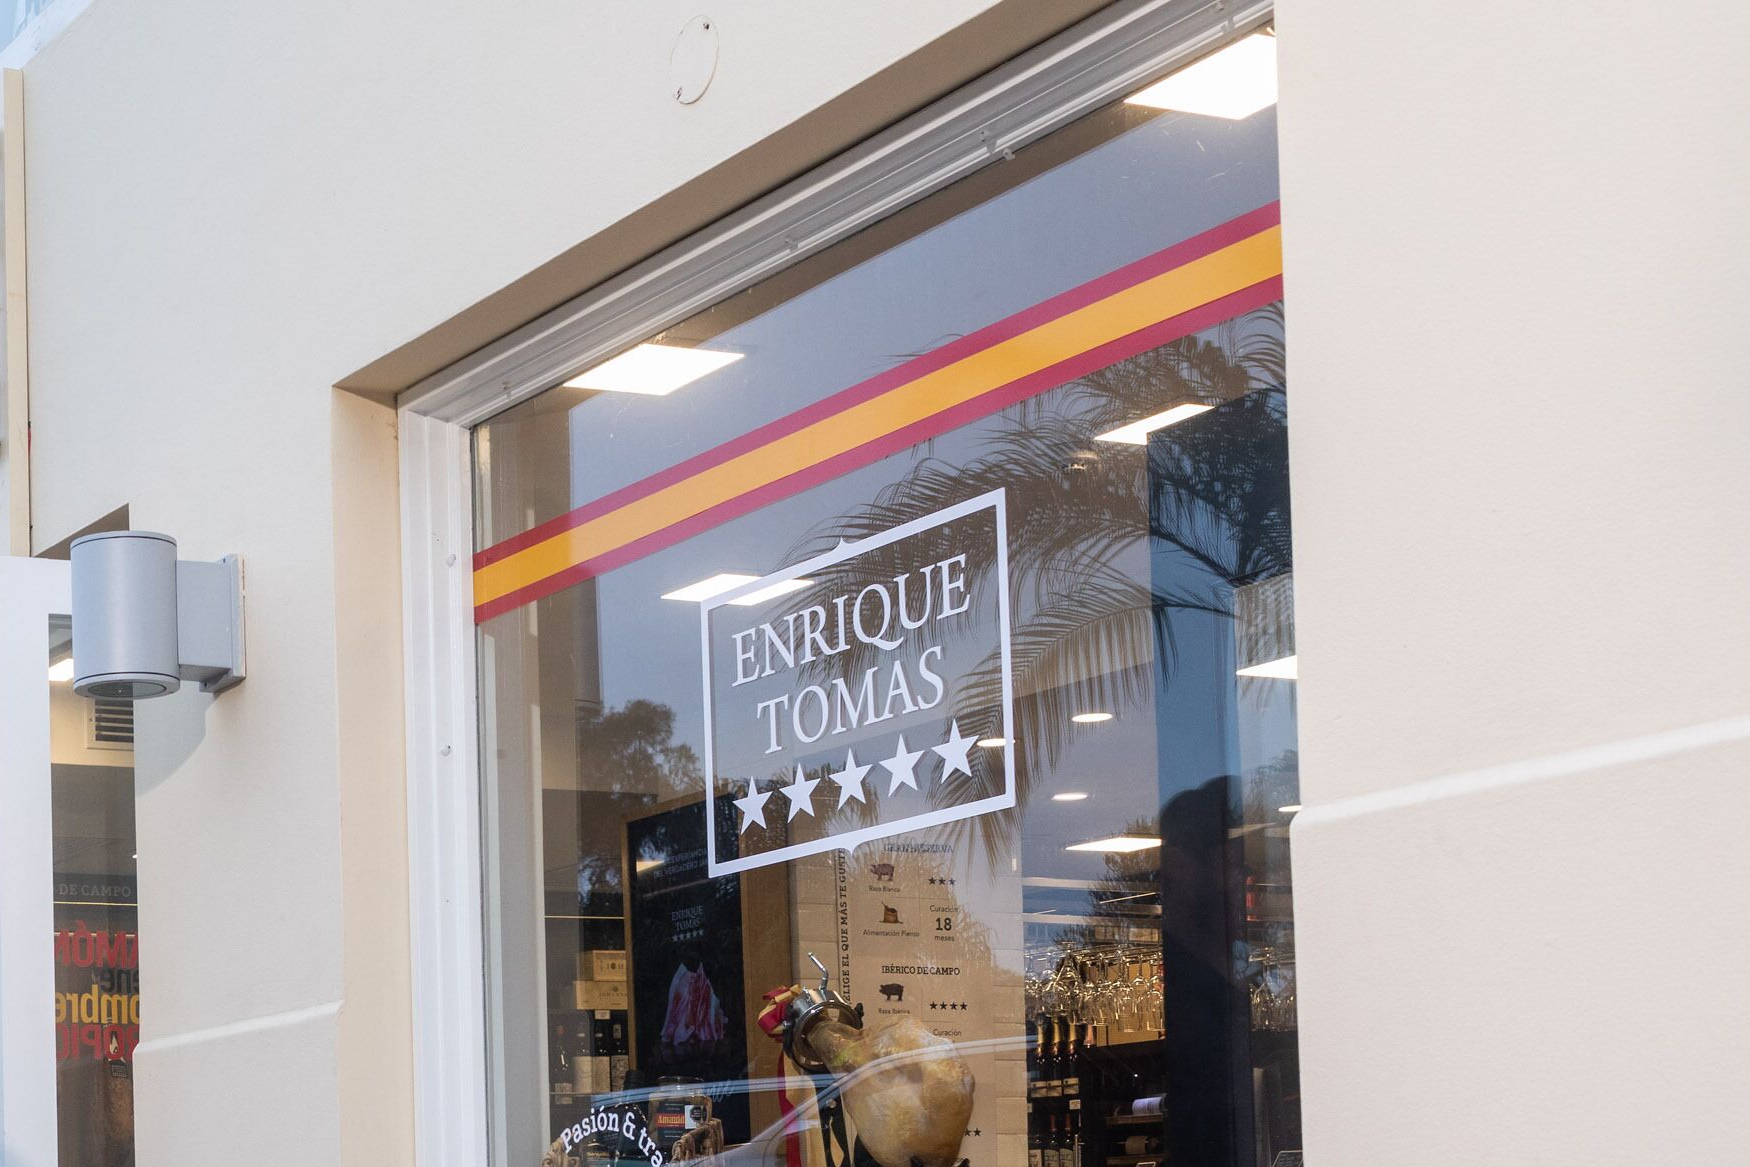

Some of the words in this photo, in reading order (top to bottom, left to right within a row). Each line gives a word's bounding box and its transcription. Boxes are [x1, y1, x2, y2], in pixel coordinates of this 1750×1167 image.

[731, 553, 971, 687] ENRIQUE
[757, 646, 944, 754] TOMAS
[59, 883, 78, 896] DE
[81, 885, 131, 898] CAMPO
[839, 885, 848, 899] TE
[839, 902, 849, 926] MÁS
[930, 904, 959, 913] Curación
[935, 917, 952, 931] 18
[841, 929, 850, 952] QUE
[842, 954, 850, 967] EL
[882, 963, 916, 974] IBÉRICO
[917, 966, 928, 975] DE
[930, 966, 960, 975] CAMPO
[932, 1028, 962, 1037] Curación
[560, 1105, 620, 1154] Pasión
[623, 1111, 636, 1141] &
